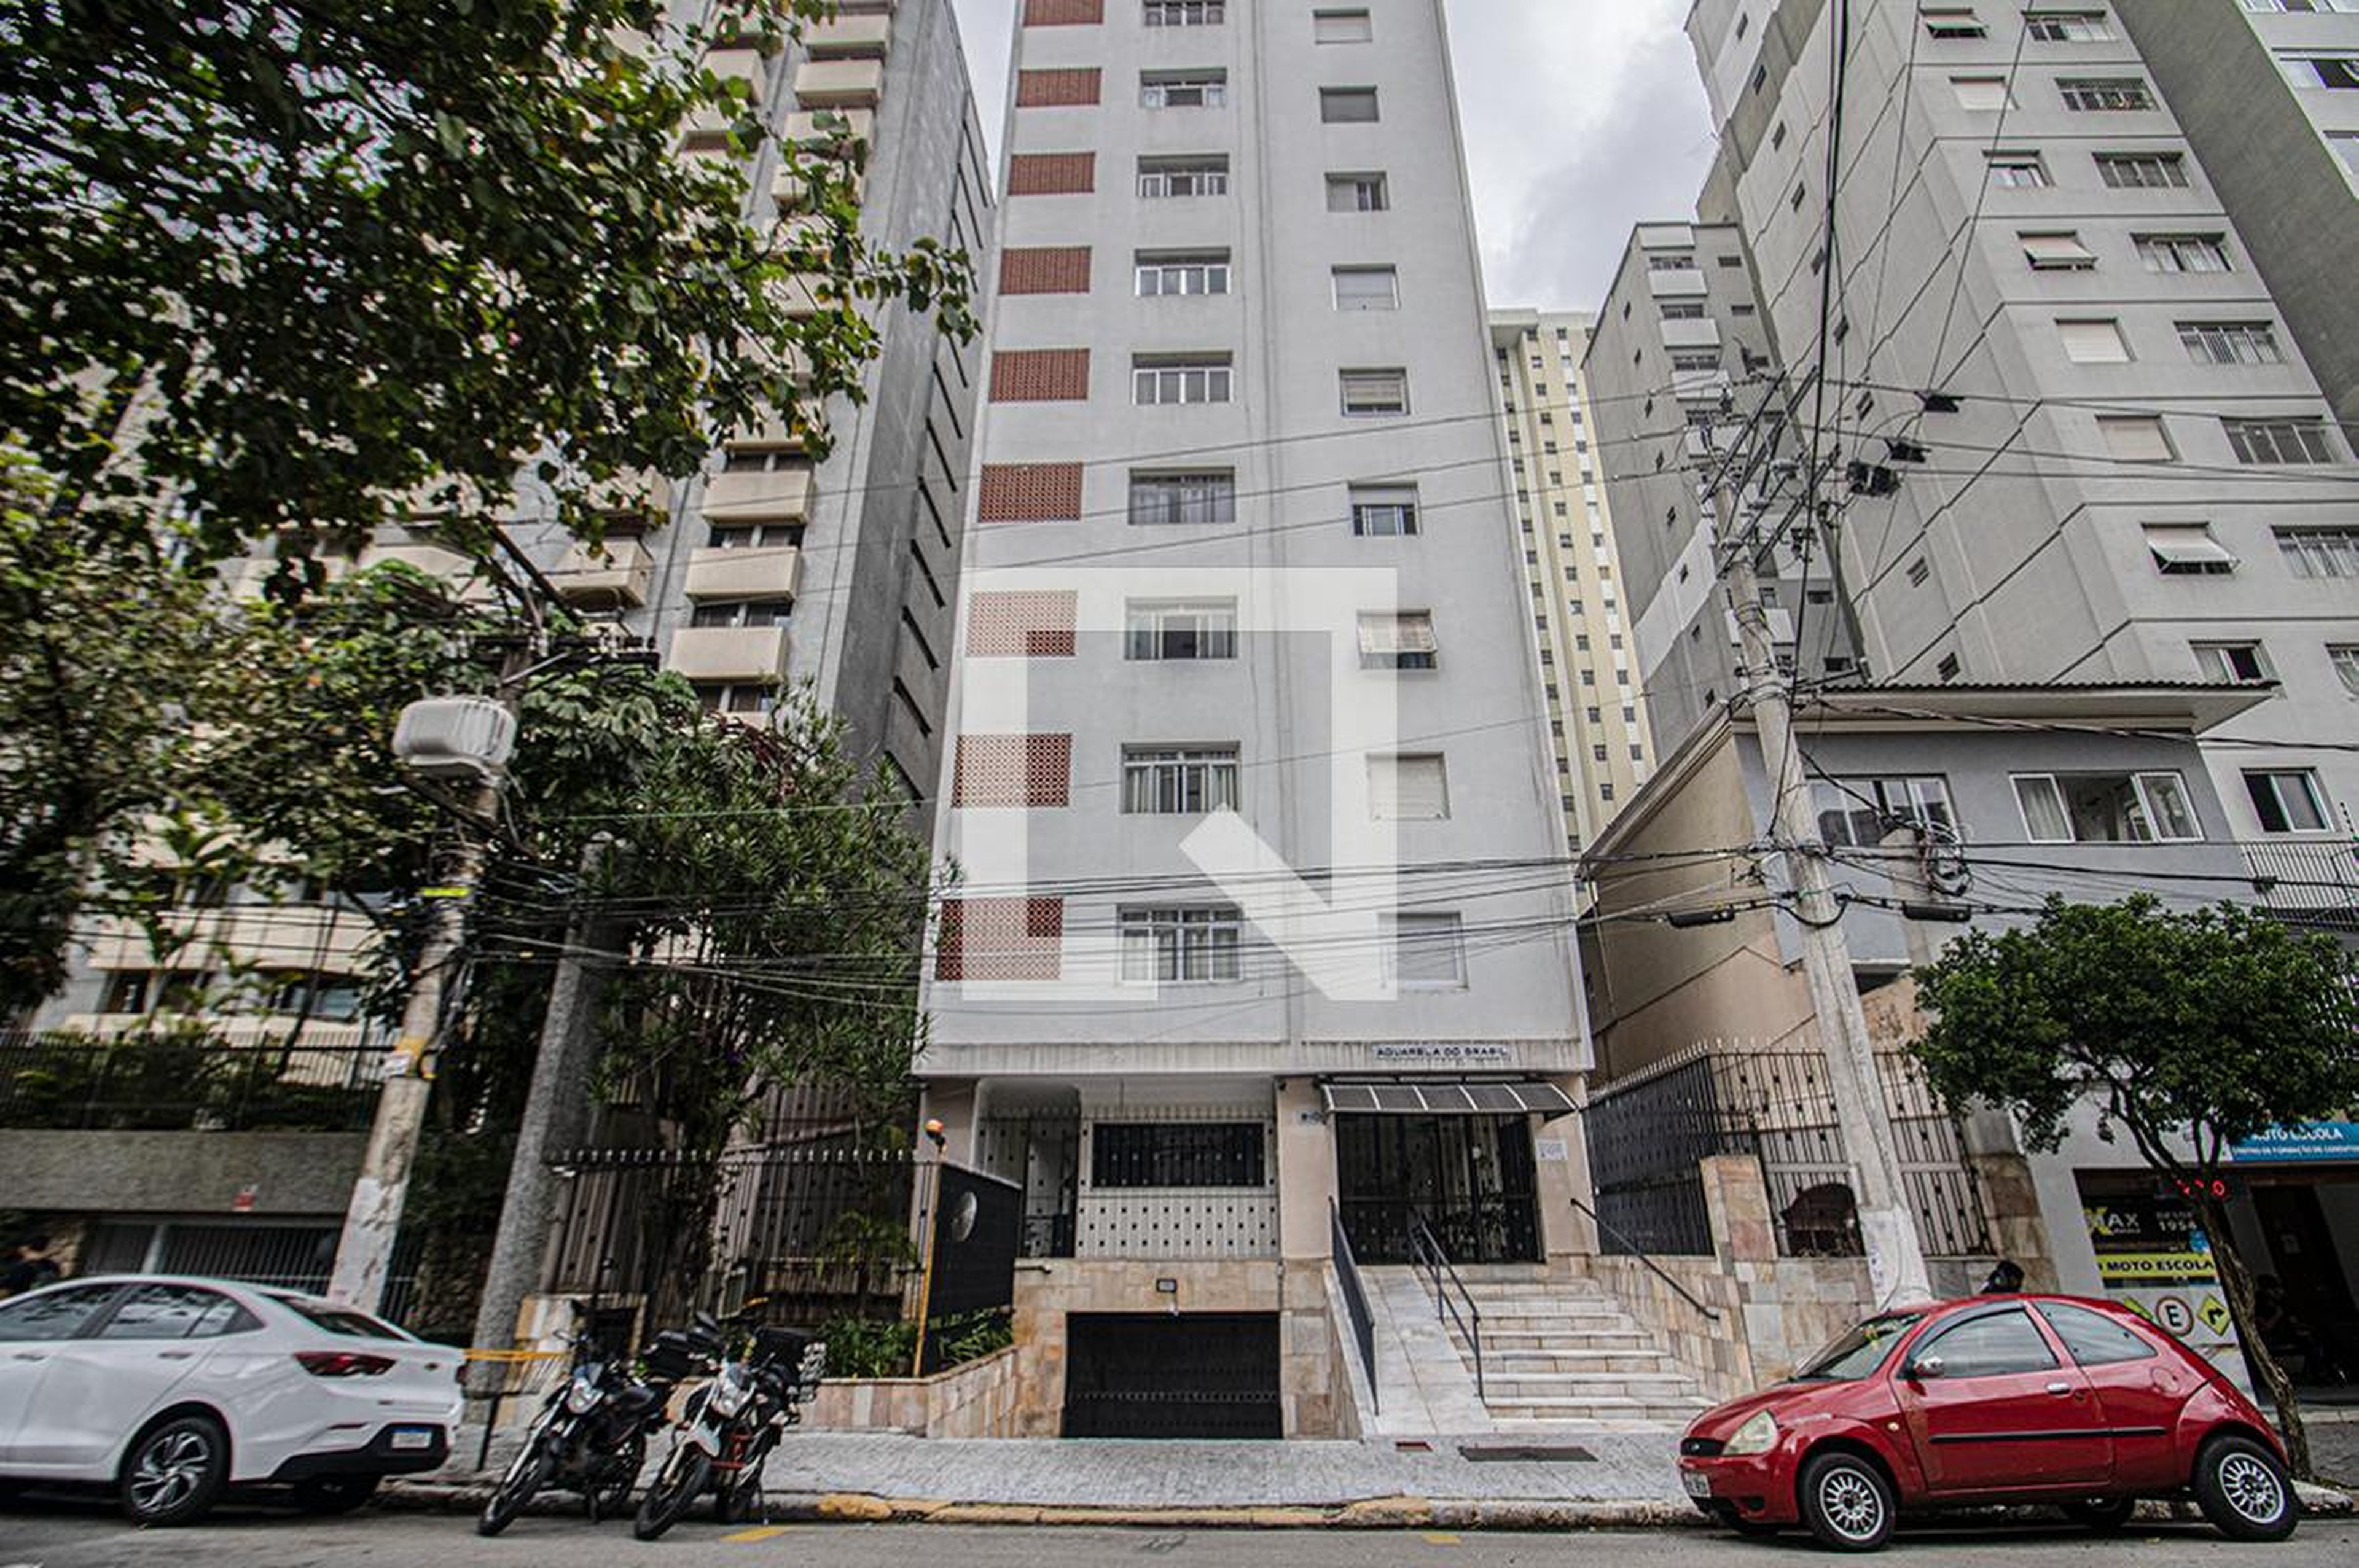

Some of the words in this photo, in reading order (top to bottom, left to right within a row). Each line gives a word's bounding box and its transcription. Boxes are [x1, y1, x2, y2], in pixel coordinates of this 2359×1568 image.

[1443, 1047, 1461, 1056] DO
[2107, 1260, 2153, 1271] MOTO
[2156, 1260, 2215, 1271] ESCOLA
[2165, 1305, 2183, 1327] E
